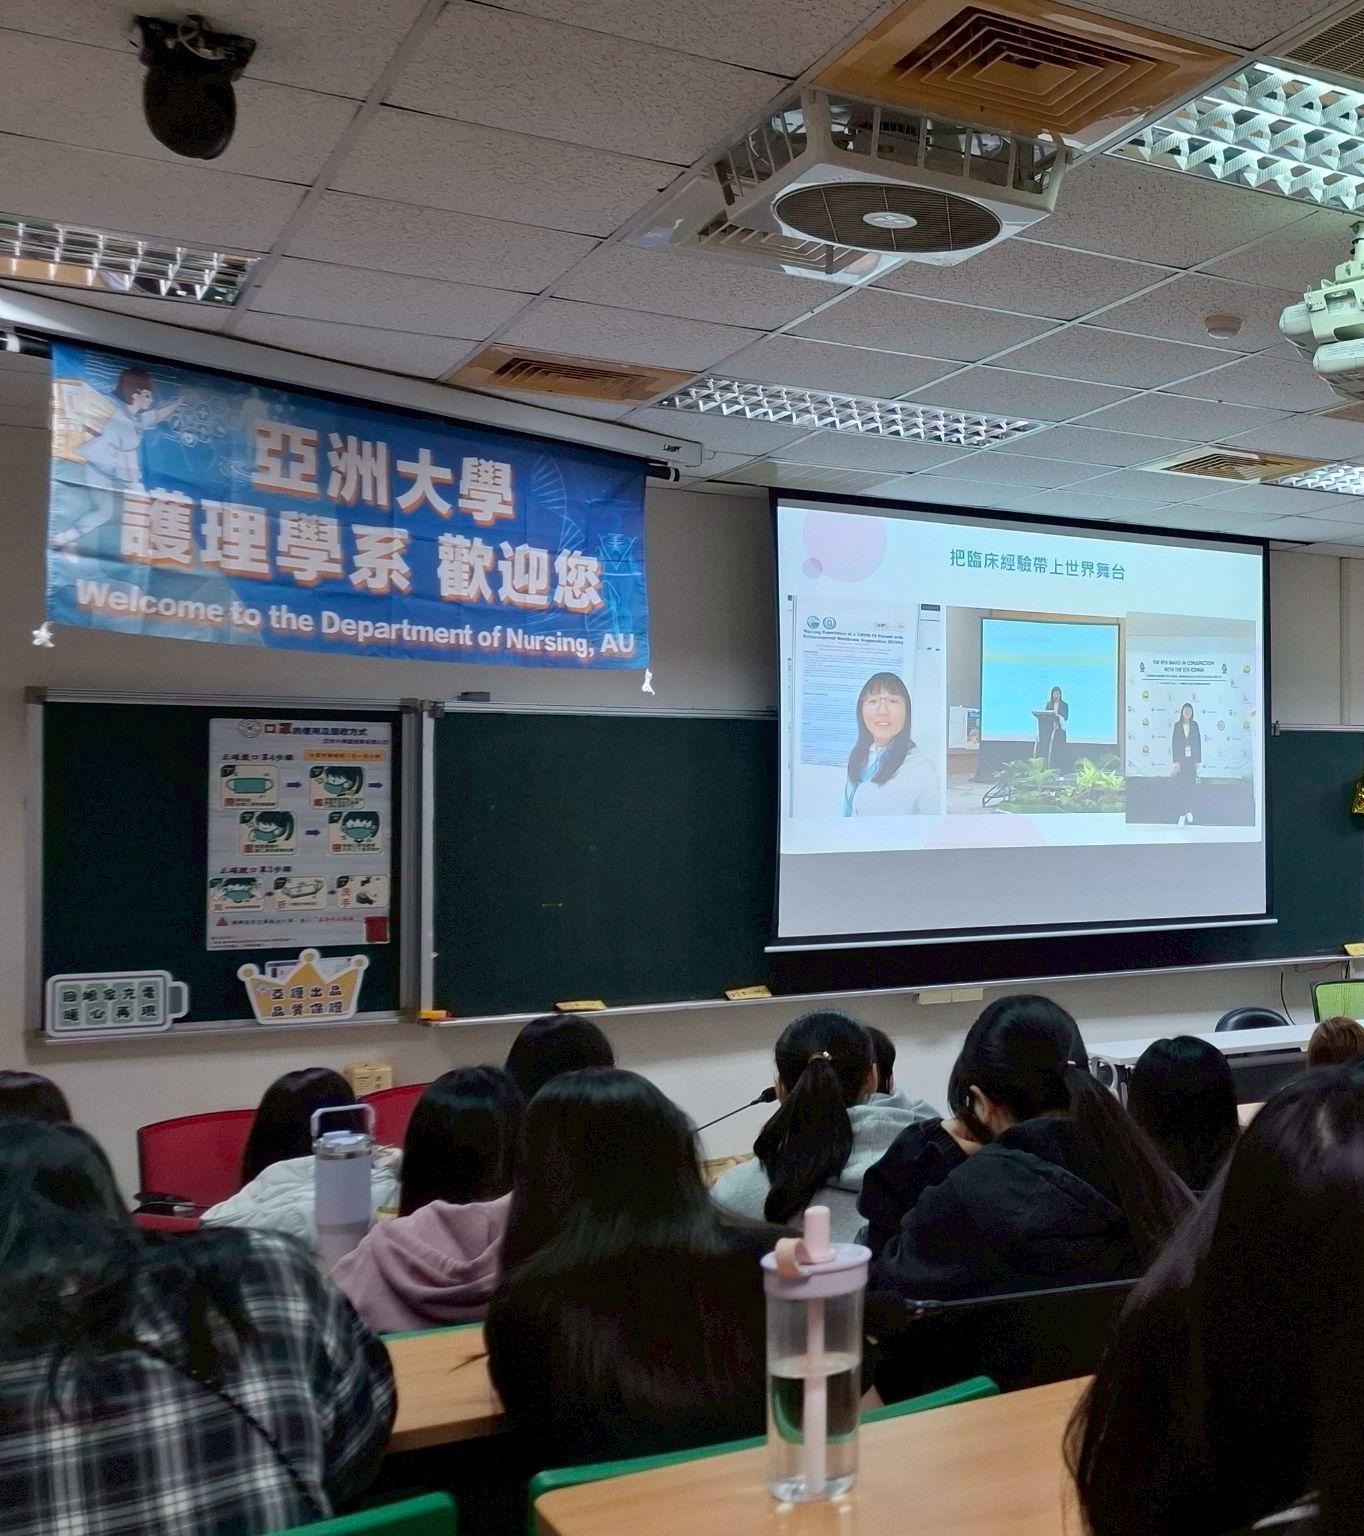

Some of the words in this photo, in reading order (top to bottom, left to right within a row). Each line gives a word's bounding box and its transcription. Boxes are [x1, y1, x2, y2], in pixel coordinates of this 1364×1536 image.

[250, 420, 516, 523] 亞洲大學
[120, 487, 411, 592] 護理學系
[437, 533, 604, 611] 歡迎您
[949, 548, 1126, 581] 把臨床經驗帶上世界舞台
[76, 578, 223, 624] Welcome
[227, 604, 261, 628] to
[269, 605, 314, 634] the
[321, 610, 473, 652] Department
[477, 625, 501, 649] of
[506, 627, 595, 658] Nursing,
[600, 632, 635, 654] AU
[63, 985, 156, 1002] 回娘家充電
[271, 1001, 343, 1017] 品質保證
[63, 1004, 157, 1021] 暖心再現
